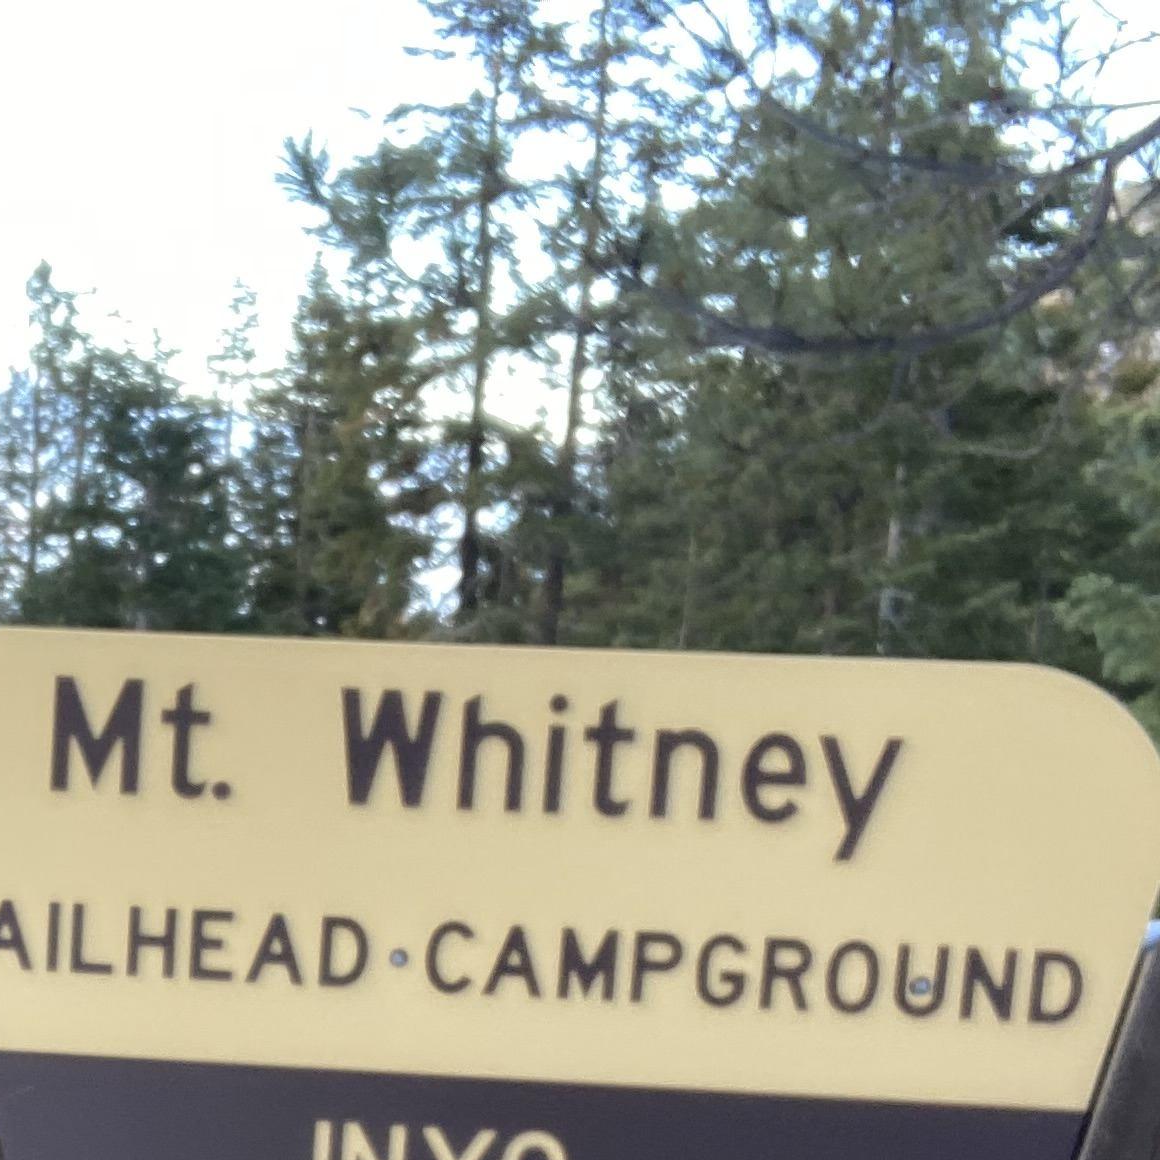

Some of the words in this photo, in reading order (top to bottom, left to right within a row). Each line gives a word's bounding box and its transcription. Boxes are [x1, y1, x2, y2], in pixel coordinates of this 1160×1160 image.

[50, 675, 232, 800] Mt.
[341, 687, 903, 862] Whitney
[425, 920, 1084, 1026] CAMPGROUND
